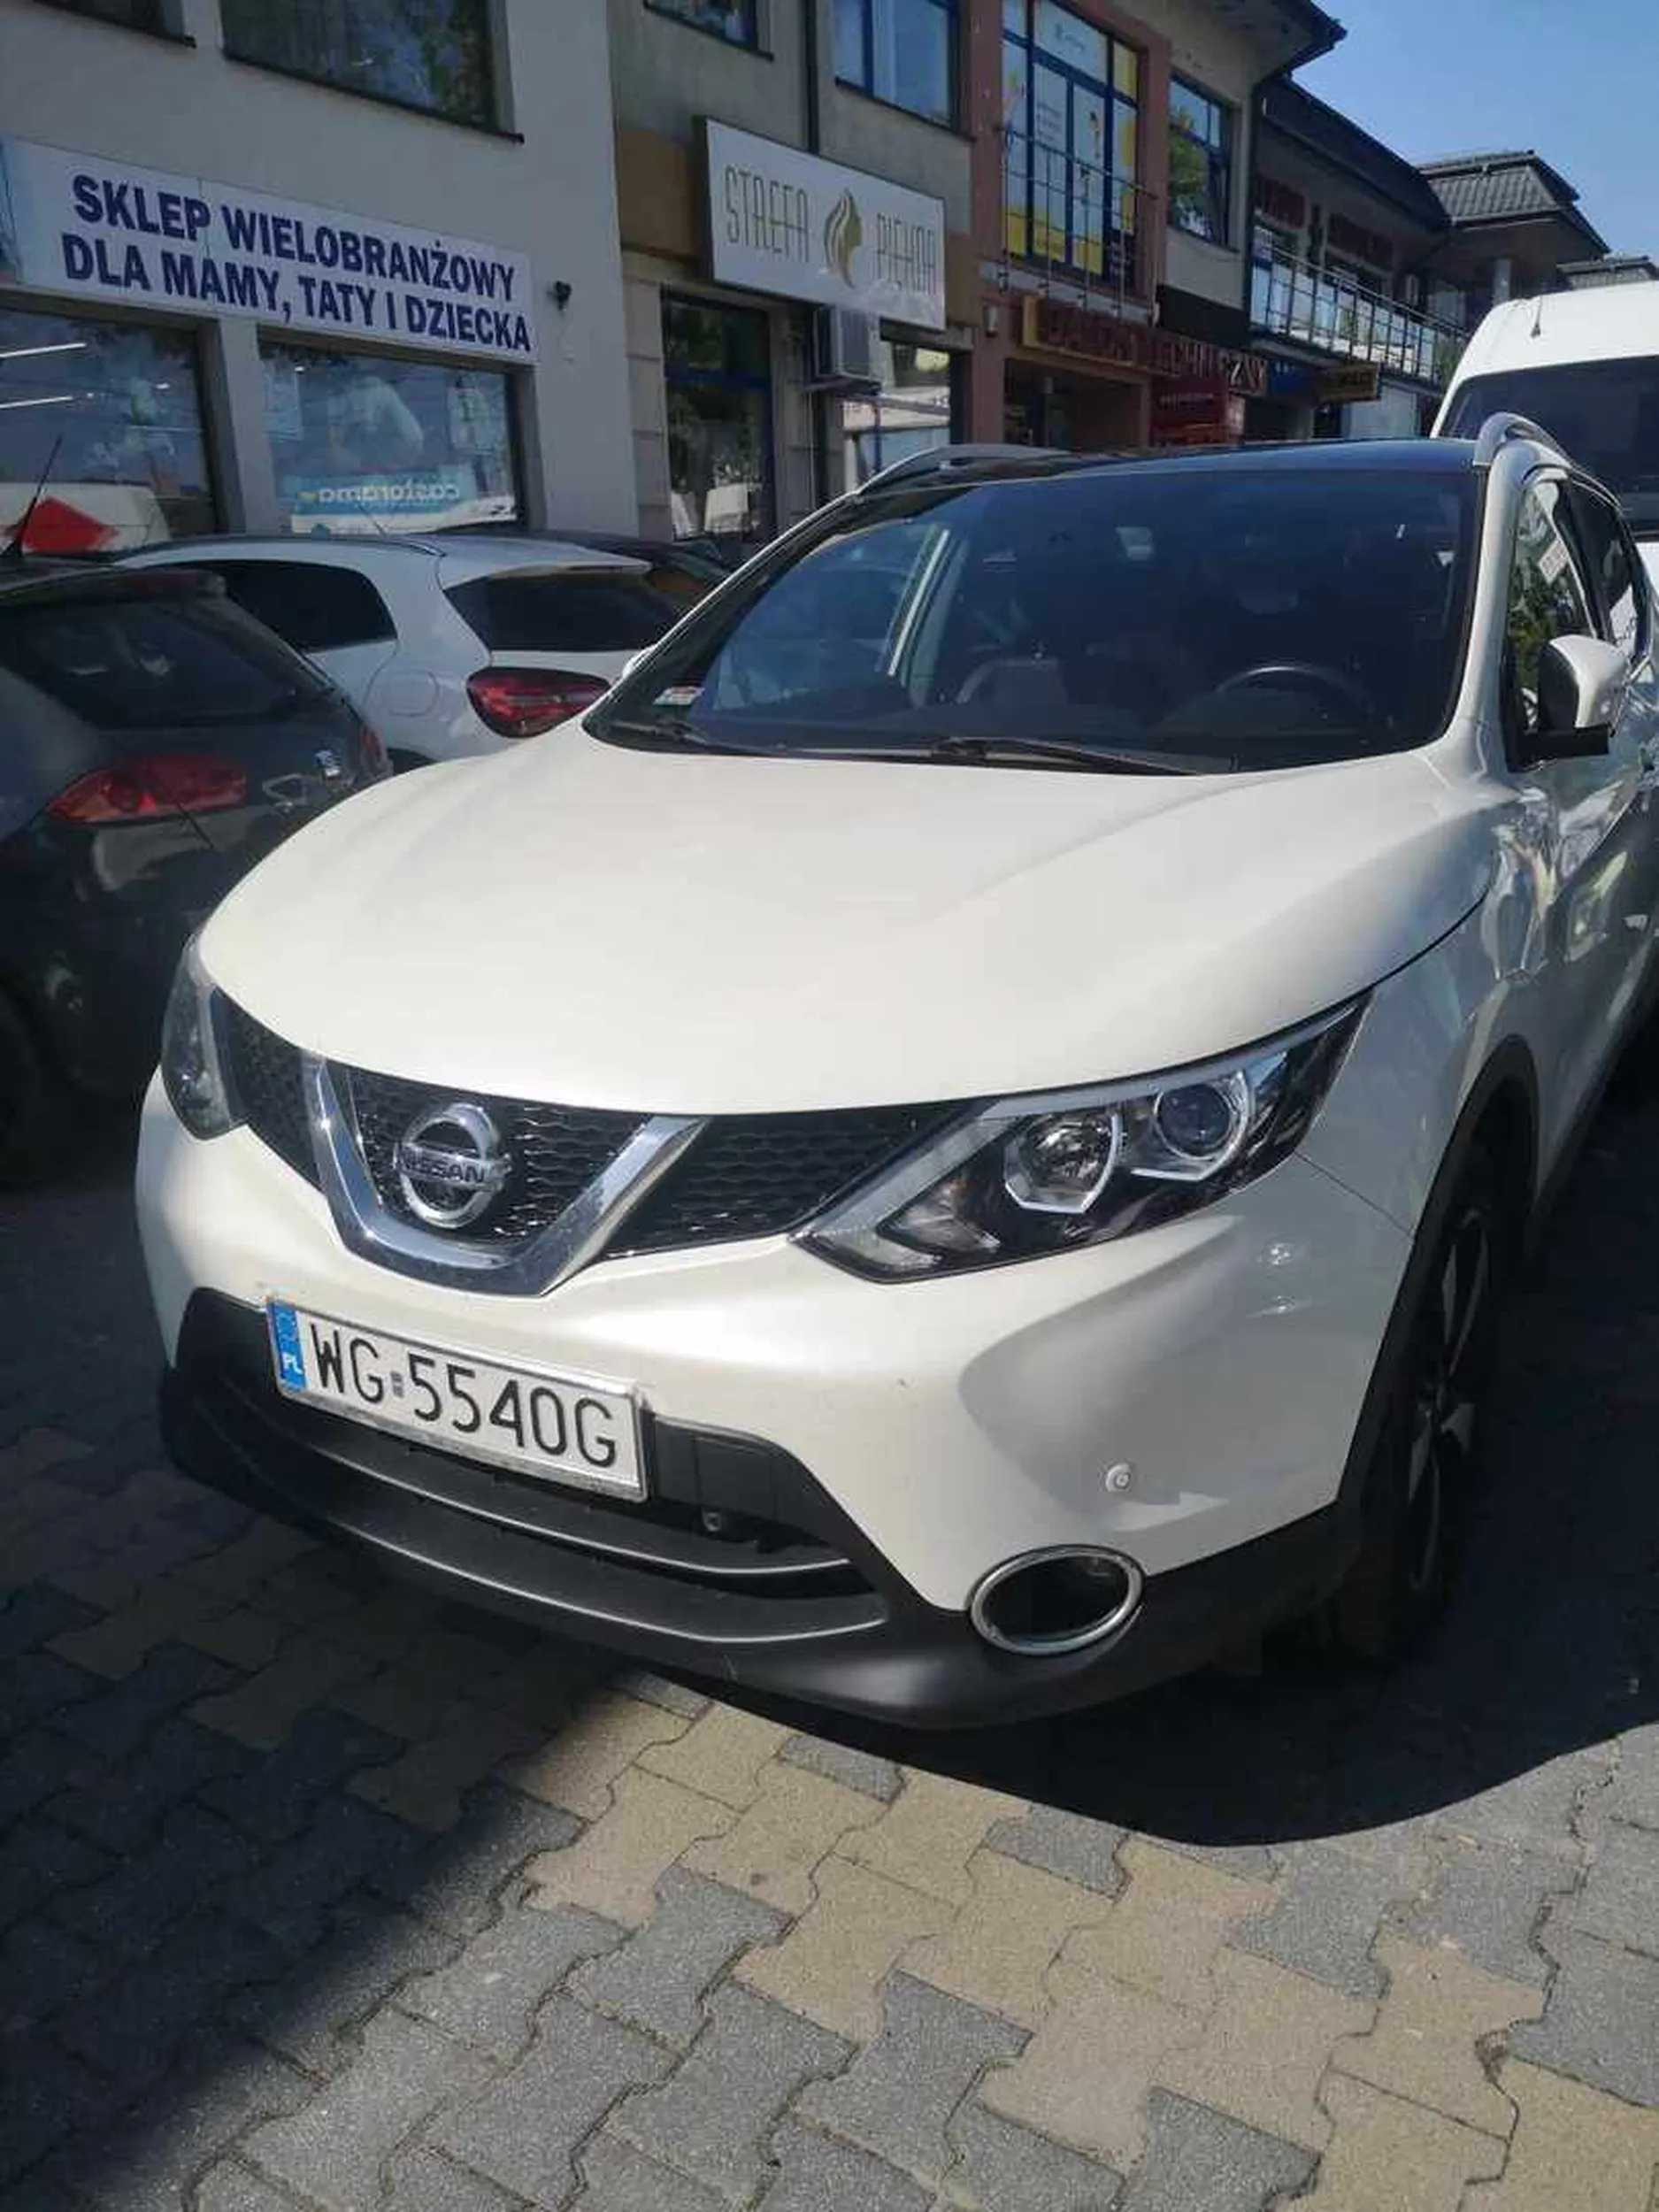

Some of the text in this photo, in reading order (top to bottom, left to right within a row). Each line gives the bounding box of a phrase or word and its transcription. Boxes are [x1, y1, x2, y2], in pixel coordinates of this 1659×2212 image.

[62, 232, 532, 353] DLA MAMY, TATY I DZIECKA
[73, 174, 515, 302] SKLEP WIELOBRANŻOWY
[310, 1323, 618, 1469] WG 5540G
